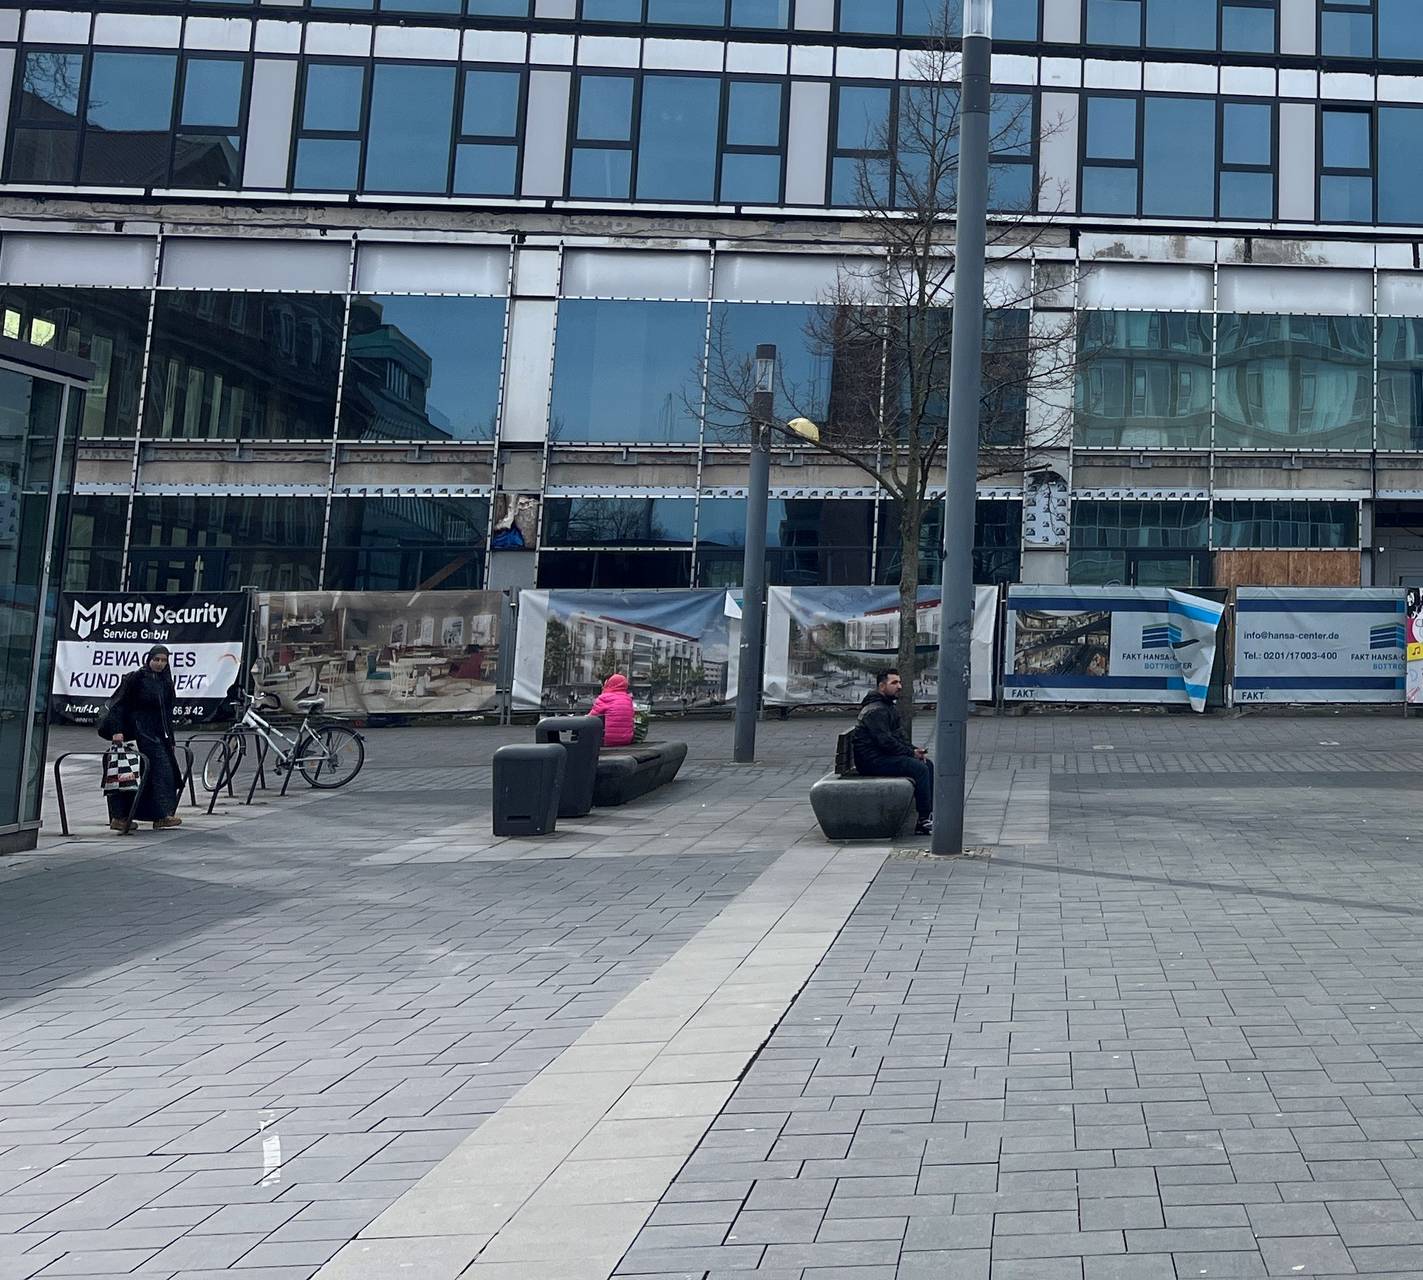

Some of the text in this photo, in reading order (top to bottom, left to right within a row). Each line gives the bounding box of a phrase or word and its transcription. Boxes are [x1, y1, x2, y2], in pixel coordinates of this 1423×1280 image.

[103, 602, 228, 628] MSM Security
[103, 628, 138, 639] Service
[1243, 631, 1339, 640] info@hansa-center.de
[92, 650, 196, 667] BEWACES
[1243, 651, 1338, 660] Tel.: 0201/17003-400
[1011, 689, 1034, 698] FAKT
[1241, 691, 1264, 700] FAKT
